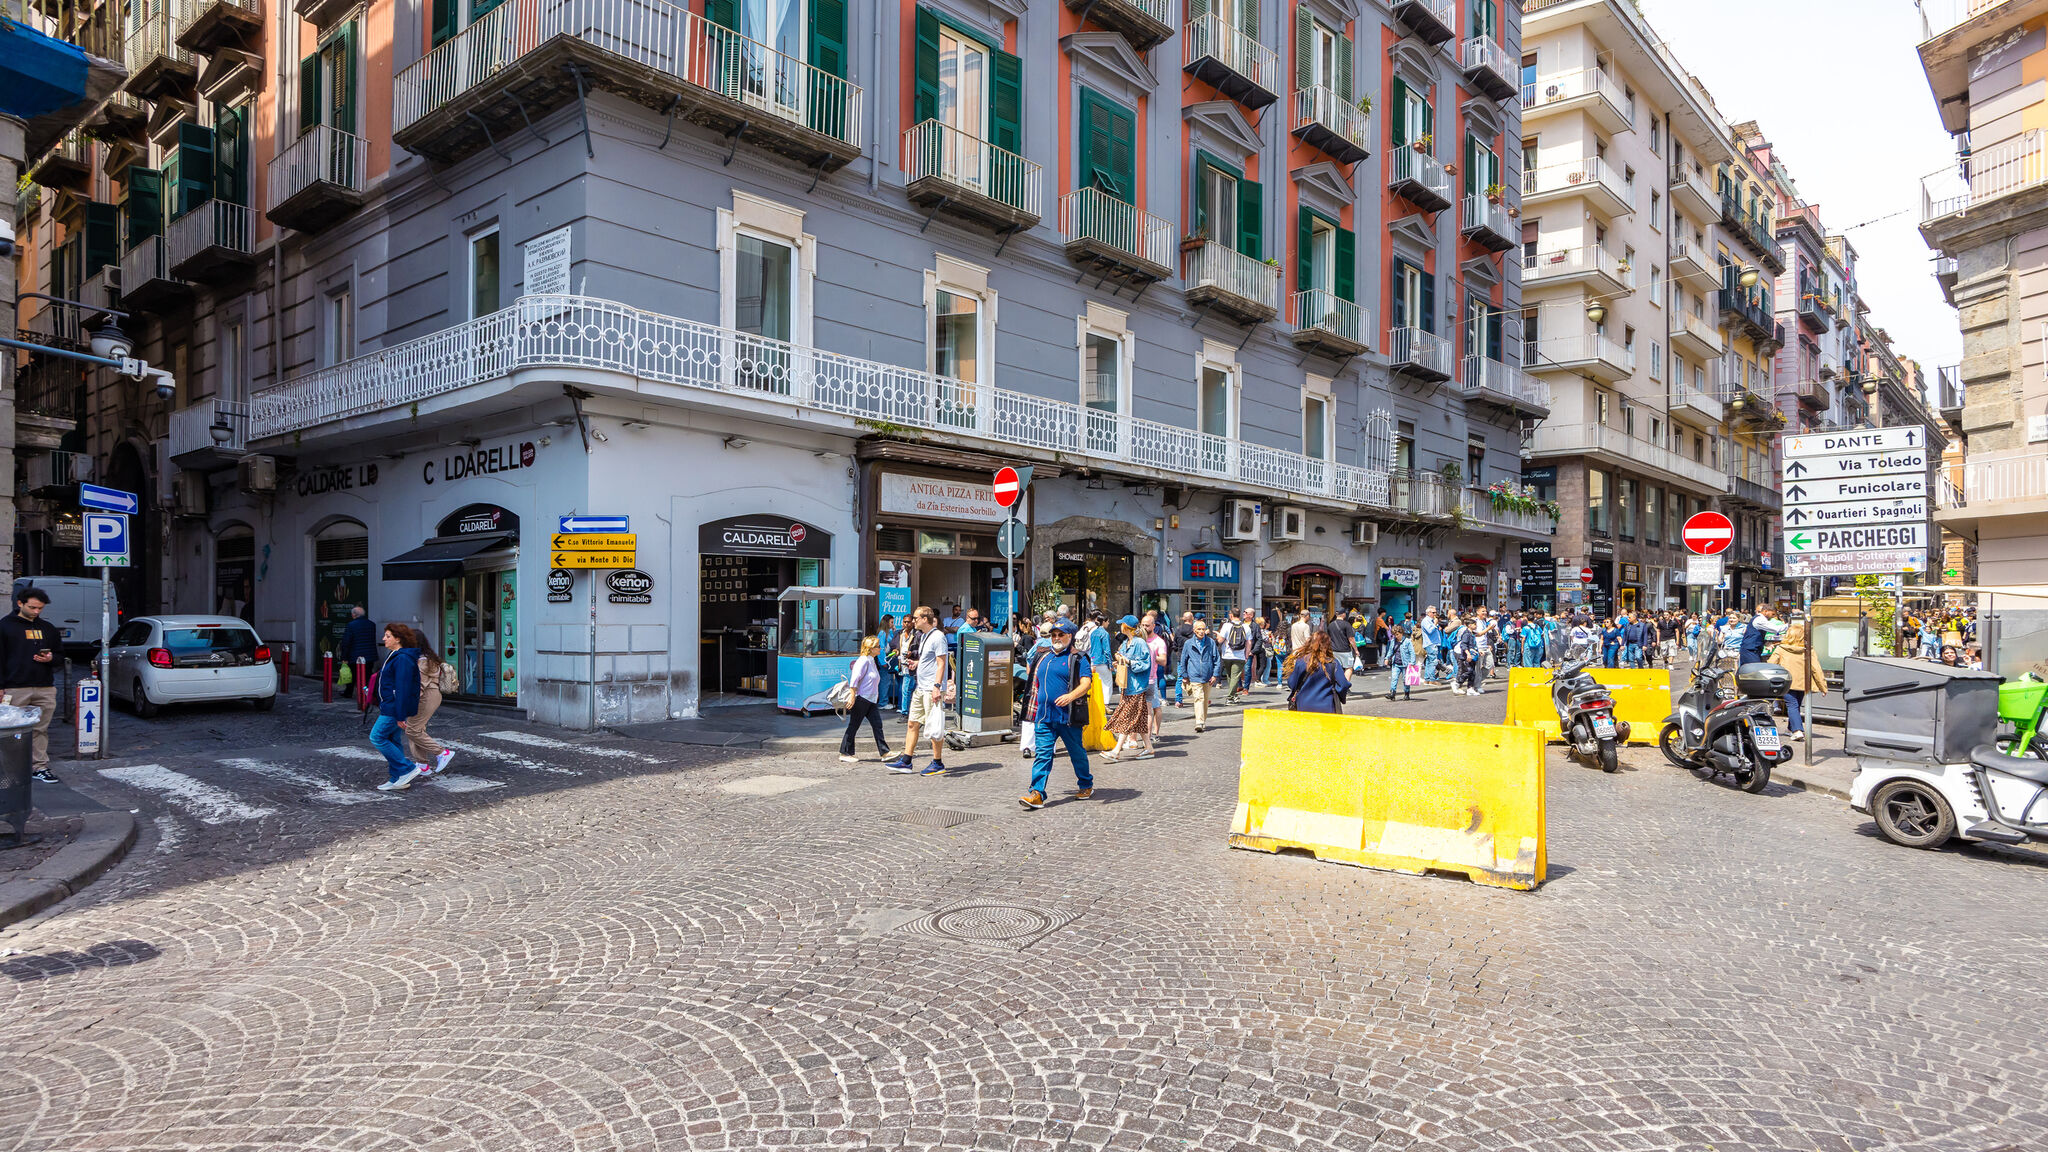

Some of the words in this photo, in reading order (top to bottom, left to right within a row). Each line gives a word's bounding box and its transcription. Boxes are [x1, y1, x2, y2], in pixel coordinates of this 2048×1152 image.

[1825, 435, 1883, 450] DANTE
[1839, 459, 1862, 471] Via
[1868, 456, 1922, 470] Toledo
[910, 483, 945, 497] ANTICA
[947, 487, 972, 500] PIZZA
[1839, 481, 1921, 495] Funicolare
[916, 501, 926, 510] da
[928, 502, 938, 510] Zia
[940, 503, 968, 514] Esterina
[970, 506, 996, 516] Sorbillo
[1817, 508, 1867, 520] Quartieri
[1873, 504, 1921, 518] Spagnoli
[460, 520, 496, 532] CALDARELLI
[90, 518, 122, 550] P
[723, 532, 797, 546] CALDARELLI
[1818, 527, 1915, 549] PARCHEGGI
[1058, 552, 1084, 562] SHOWBIZ
[1819, 553, 1853, 562] Napoli
[1856, 551, 1920, 560] Sotterranea
[1206, 560, 1232, 578] TIM
[1820, 564, 1854, 572] Naples
[548, 576, 570, 586] kenon
[612, 576, 648, 587] kenon
[1462, 574, 1488, 584] FIORENZANO
[885, 592, 904, 600] Antica
[882, 601, 907, 612] Pizza
[994, 604, 1009, 614] Pizz
[84, 688, 97, 701] P
